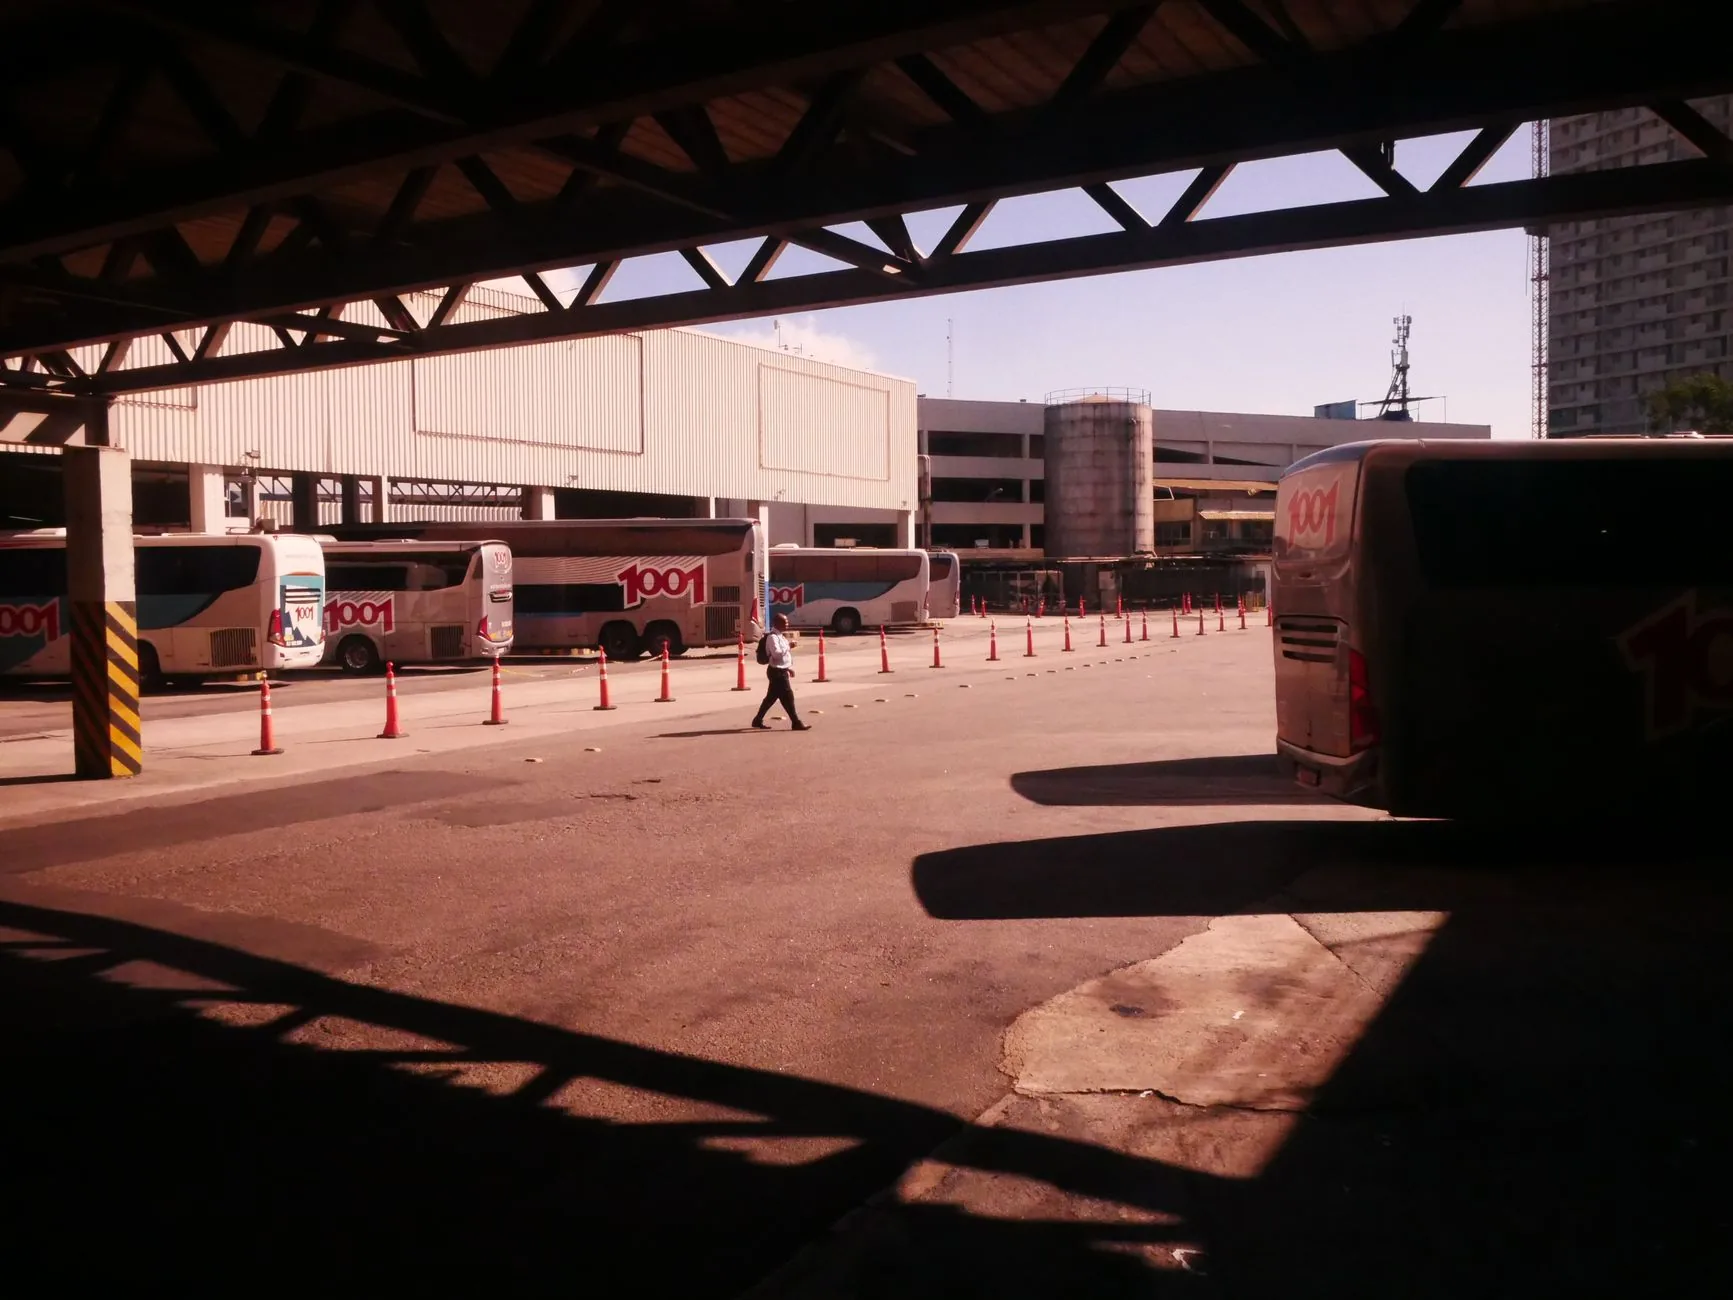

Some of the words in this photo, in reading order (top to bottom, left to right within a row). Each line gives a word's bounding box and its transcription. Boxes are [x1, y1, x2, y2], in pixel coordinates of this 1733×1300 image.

[1287, 477, 1340, 549] 1001
[617, 558, 707, 608] 1001
[295, 605, 314, 622] 1001
[323, 595, 395, 635] 1001
